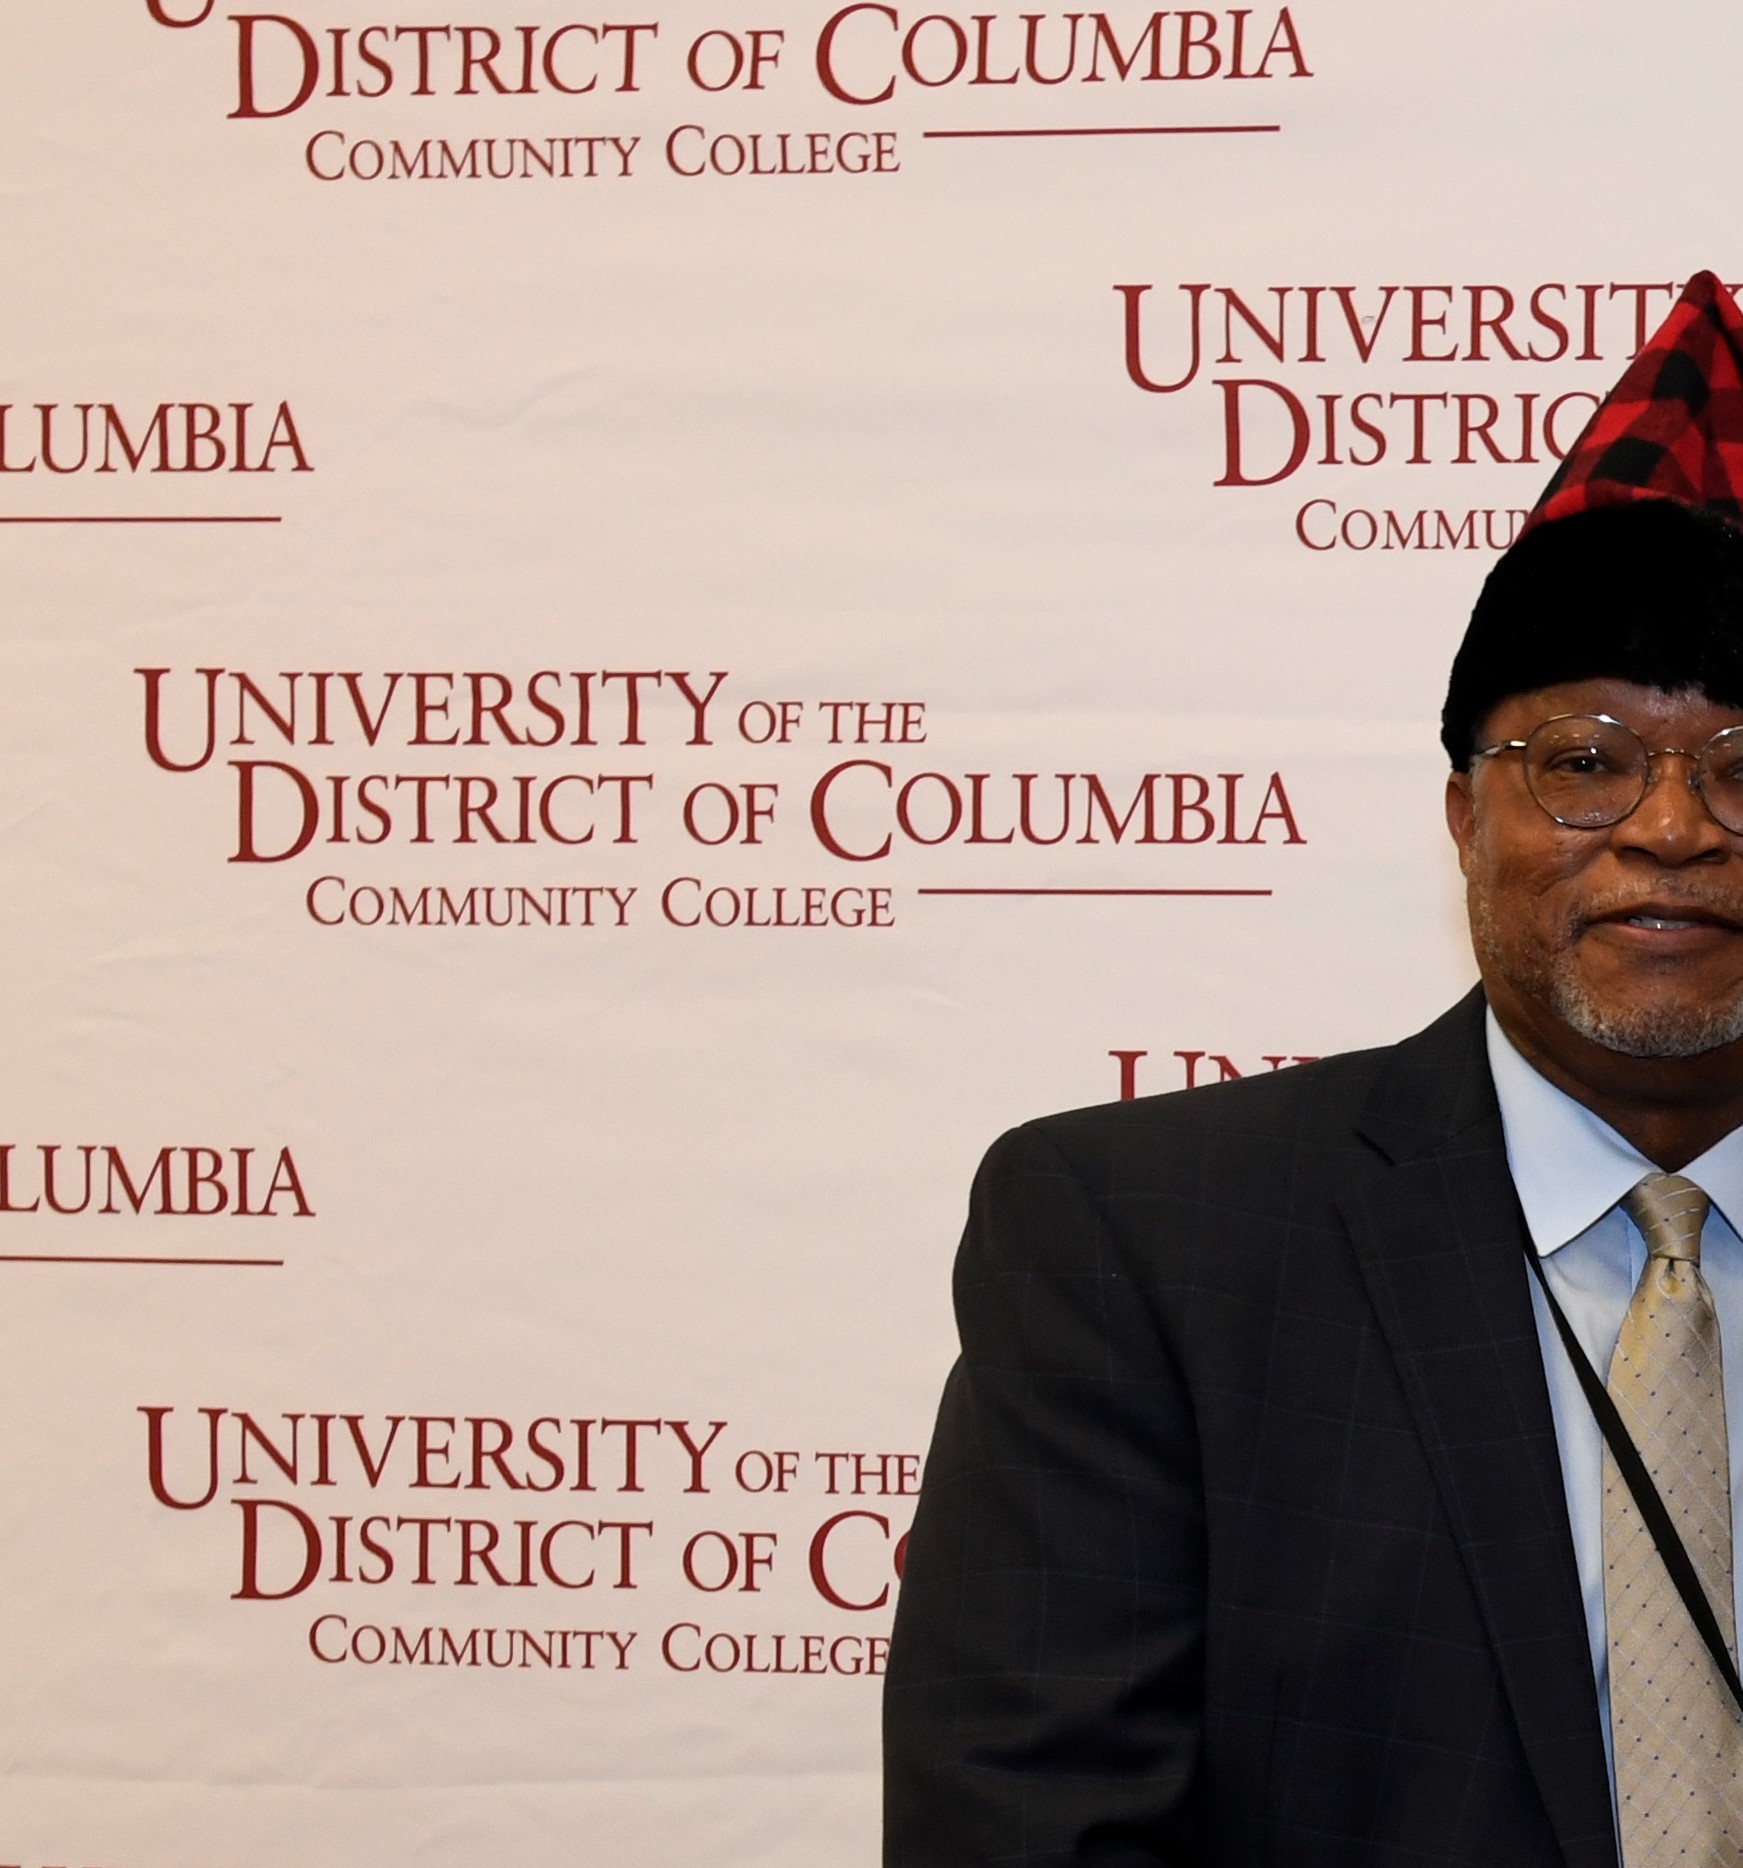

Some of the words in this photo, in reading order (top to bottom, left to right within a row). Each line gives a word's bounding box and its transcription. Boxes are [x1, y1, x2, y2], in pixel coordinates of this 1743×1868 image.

[228, 13, 658, 119] DISTRICT
[687, 29, 785, 92] OF
[815, 2, 1313, 106] COLUMBIA
[305, 130, 640, 180] COMMUNITY
[665, 124, 900, 177] COLLEGE
[0, 400, 315, 474] LUMBIA
[1213, 378, 1612, 487] DISTRIC
[1295, 498, 1527, 551] COMMU
[134, 667, 729, 773] UNIVERSITY
[738, 701, 803, 744] OF
[820, 702, 928, 745] THE
[228, 760, 654, 864] DISTRICT
[683, 782, 779, 846] OF
[810, 759, 1307, 862] COLUMBIA
[306, 876, 638, 928] COMMUNITY
[661, 877, 897, 928] COLLEGE
[0, 1143, 316, 1218] LUMBIA
[138, 1406, 728, 1511] UNIVERSITY
[735, 1450, 800, 1493] OF
[815, 1451, 922, 1496] THE
[231, 1498, 654, 1601] DISTRICT
[683, 1530, 777, 1592] OF
[309, 1614, 638, 1671] COMMUNITY
[661, 1622, 890, 1676] COLLEGE
